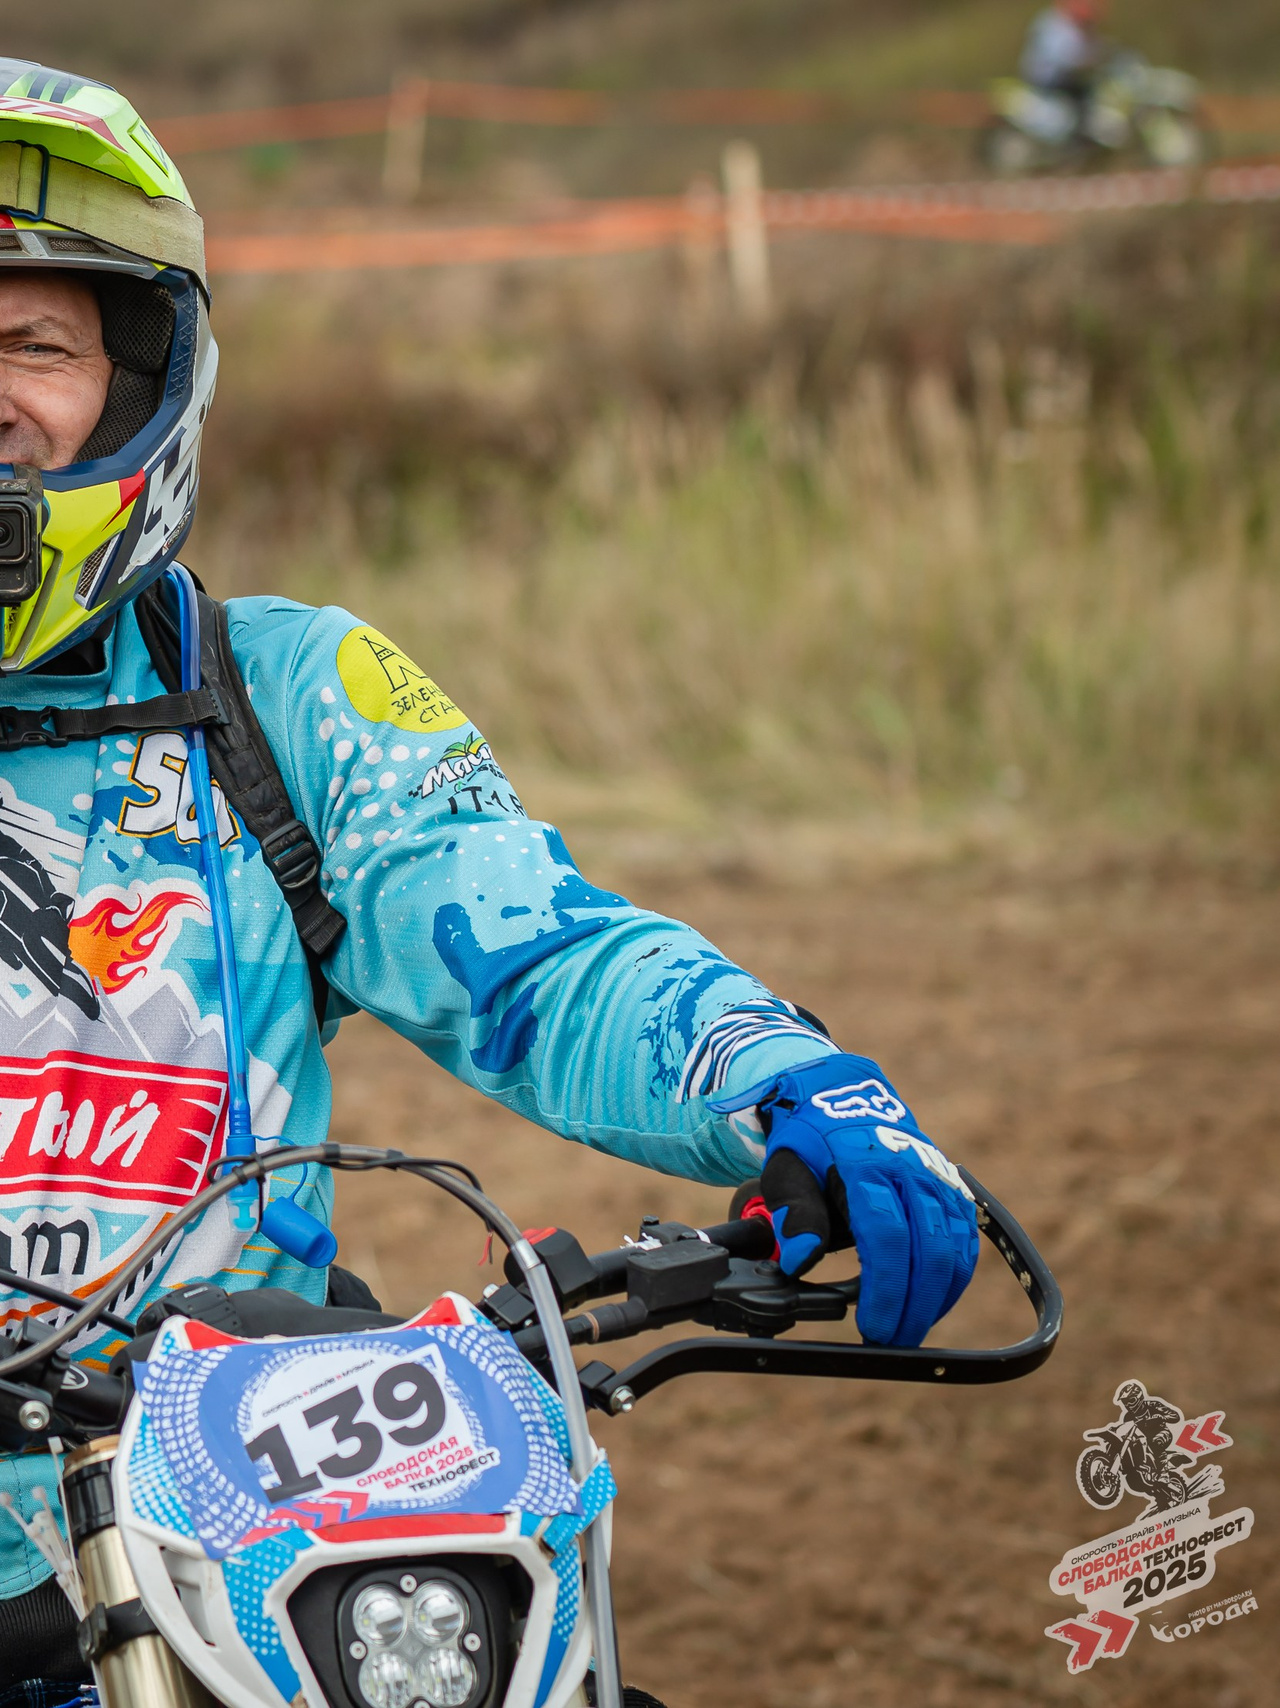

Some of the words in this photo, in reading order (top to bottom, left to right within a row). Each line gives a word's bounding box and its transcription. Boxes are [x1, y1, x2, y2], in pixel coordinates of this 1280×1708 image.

[244, 1361, 447, 1504] 139
[356, 1436, 459, 1488] СЛОБОДСКАЯ
[384, 1463, 435, 1491] БАЛКА
[435, 1446, 474, 1472] 2025
[408, 1451, 497, 1494] ТЕХНОФЕСТ
